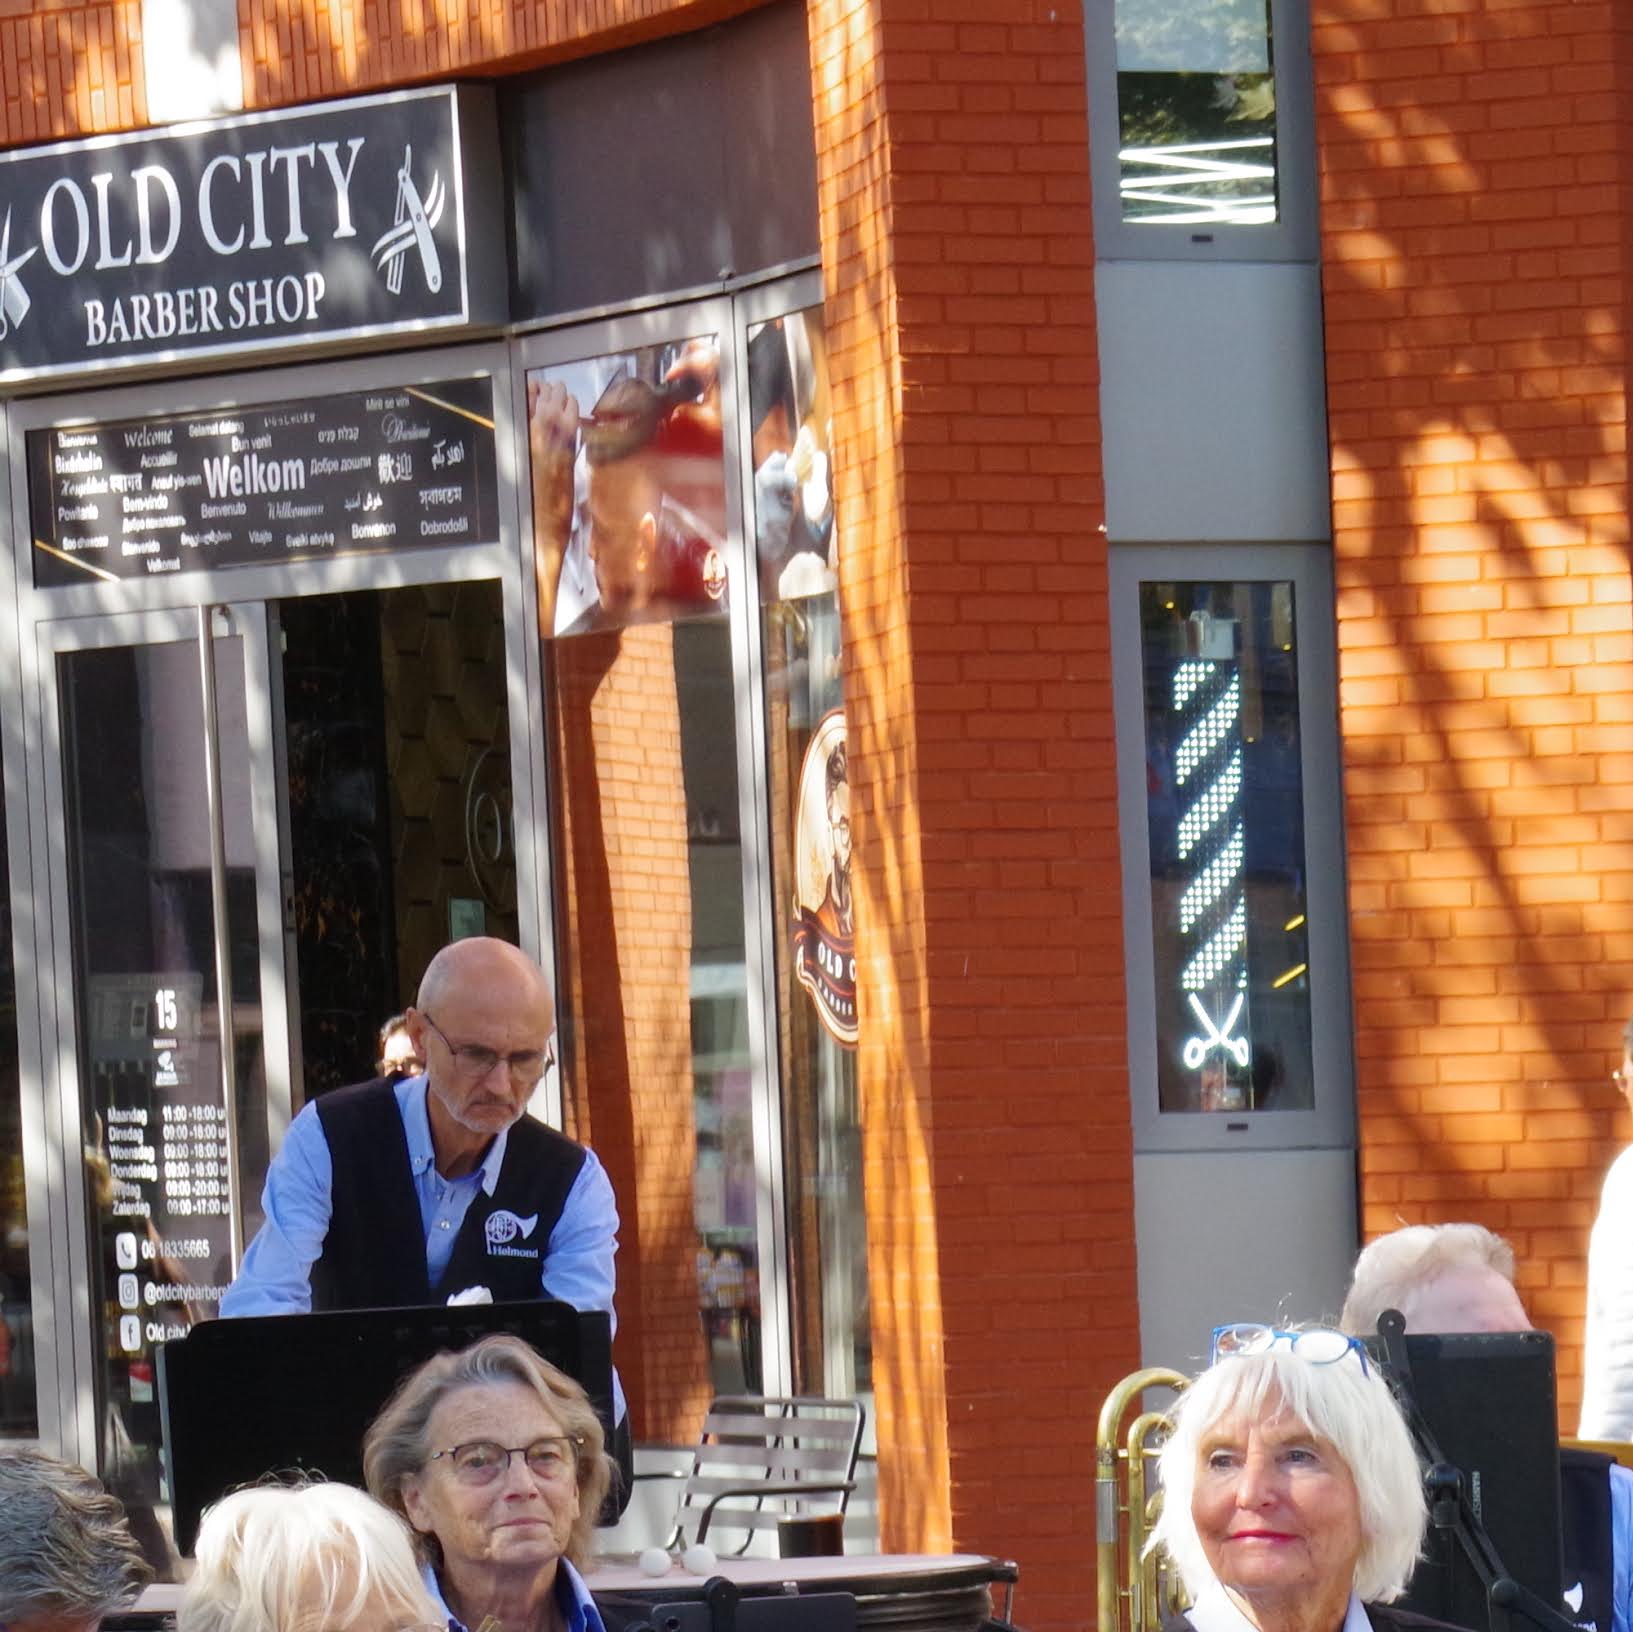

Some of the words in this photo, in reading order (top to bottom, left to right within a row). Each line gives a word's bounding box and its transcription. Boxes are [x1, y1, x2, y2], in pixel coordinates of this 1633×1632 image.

[41, 165, 181, 276] OLD
[199, 137, 365, 255] CITY
[84, 287, 224, 347] BARBER
[228, 271, 326, 330] SHOP
[203, 452, 306, 499] Welkom
[351, 522, 397, 540] Bonvenon
[818, 941, 844, 979] OLD
[155, 989, 178, 1031] 15
[107, 1105, 148, 1127] Maandag
[108, 1125, 144, 1145] Dinsdag
[141, 1239, 156, 1260] 06
[492, 1244, 539, 1259] Helmond
